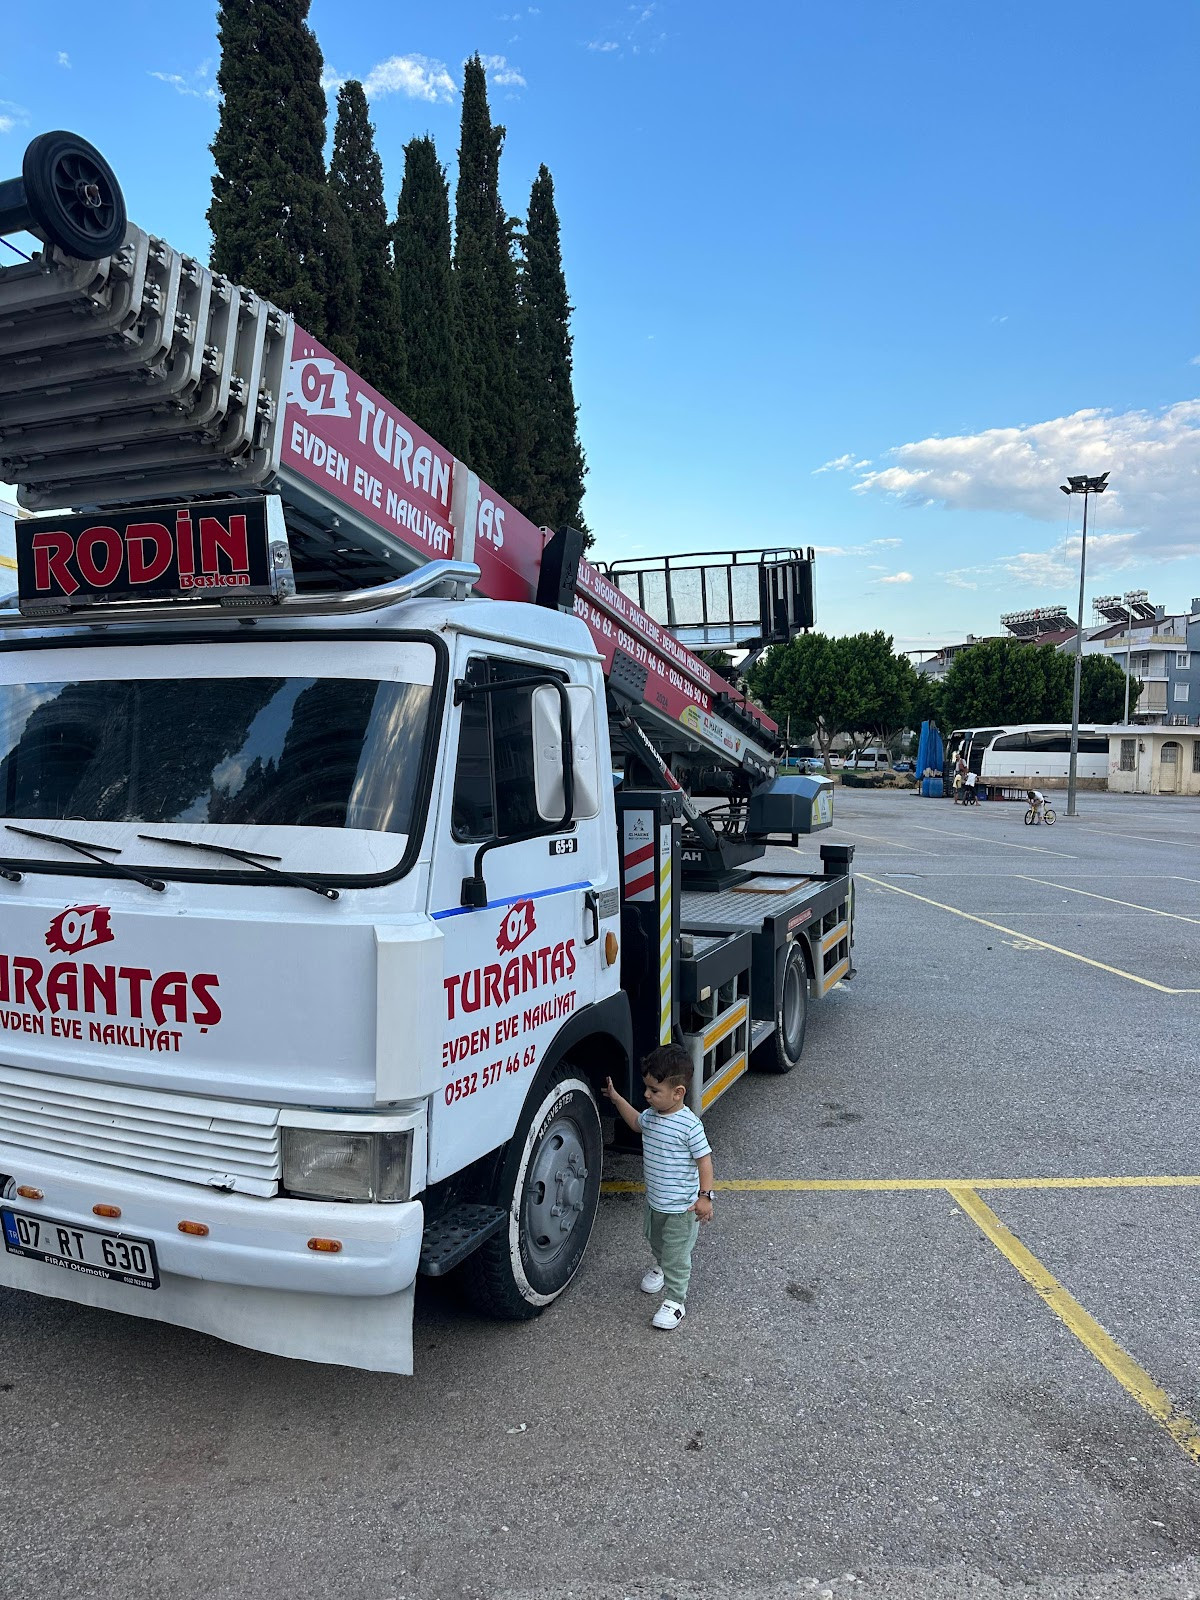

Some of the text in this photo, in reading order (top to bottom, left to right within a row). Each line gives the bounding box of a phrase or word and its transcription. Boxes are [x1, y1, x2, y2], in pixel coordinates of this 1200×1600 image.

[290, 421, 452, 554] EVDEN EVE NAKLİYAT
[32, 509, 249, 596] RODİN
[591, 608, 601, 629] 46
[602, 618, 612, 637] 62
[618, 628, 634, 655] 0532
[636, 642, 647, 663] 577
[648, 652, 657, 671] 46
[657, 660, 665, 677] 62
[629, 606, 660, 642] PAKETLEME
[681, 852, 702, 861] AH
[444, 939, 576, 1020] TURANTAŞ
[51, 1017, 83, 1040] EVE
[89, 1022, 183, 1052] NAKLİYAT
[495, 1015, 519, 1045] EVE
[523, 990, 576, 1032] NAKLİYAT
[444, 1045, 536, 1106] 0532 577 46 62
[8, 1217, 147, 1274] TR 07 RT 630
[44, 1255, 69, 1268] FIRAT
[70, 1263, 110, 1279] Otomotiv
